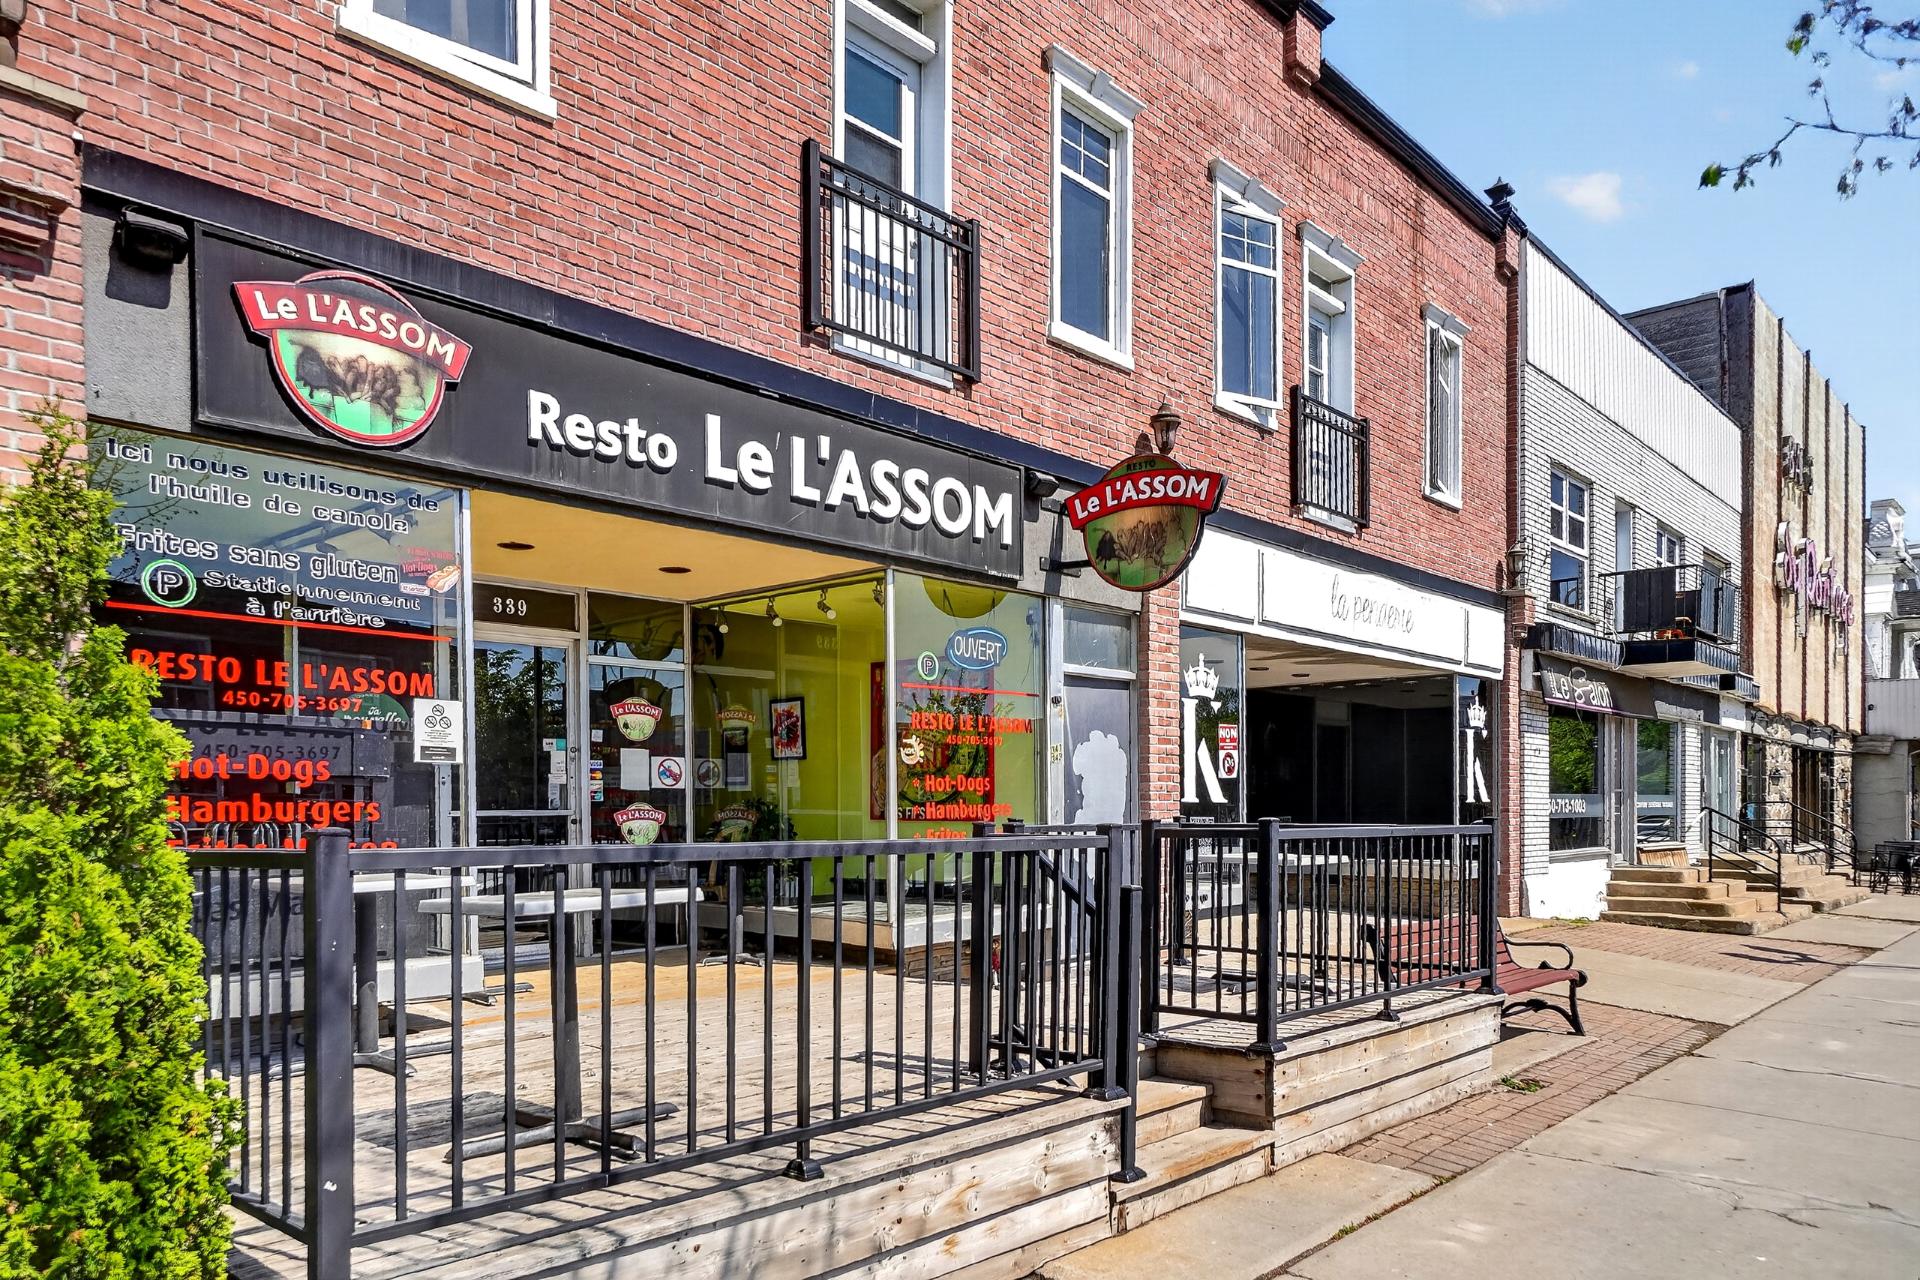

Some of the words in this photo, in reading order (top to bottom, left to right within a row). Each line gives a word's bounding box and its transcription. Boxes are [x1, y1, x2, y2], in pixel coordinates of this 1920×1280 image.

[254, 290, 298, 320] Le
[305, 292, 457, 367] L'ASSOM
[105, 437, 152, 464] Ici
[167, 452, 250, 481] nous
[263, 468, 398, 506] utilisons
[407, 492, 440, 513] de
[527, 388, 679, 474] Resto
[704, 413, 775, 495] Le
[789, 434, 1013, 548] L'ASSOM
[1126, 459, 1156, 472] RESTO
[149, 472, 251, 508] l'huile
[263, 493, 301, 516] de
[312, 507, 409, 535] canola
[1074, 496, 1100, 520] Le
[1105, 475, 1210, 508] L'ASSOM
[115, 522, 218, 560] Frites
[229, 544, 301, 571] sans
[309, 553, 399, 585] gluten
[203, 570, 421, 611] Stationnement
[245, 597, 265, 616] à
[273, 601, 386, 628] l'arrière
[493, 597, 527, 616] 339
[954, 635, 1003, 664] OUVERT
[132, 649, 241, 684] RESTO
[256, 659, 290, 687] LE
[303, 662, 435, 698] L'ASSOM
[1552, 669, 1570, 700] Le
[223, 689, 362, 713] 450-705-3697
[614, 706, 624, 714] Le
[911, 711, 954, 731] RESTO
[960, 713, 974, 731] LE
[1220, 727, 1237, 739] NON
[925, 774, 990, 795] Hot-Dogs
[166, 792, 382, 829] Hamburgers
[925, 799, 1012, 820] Hamburgers
